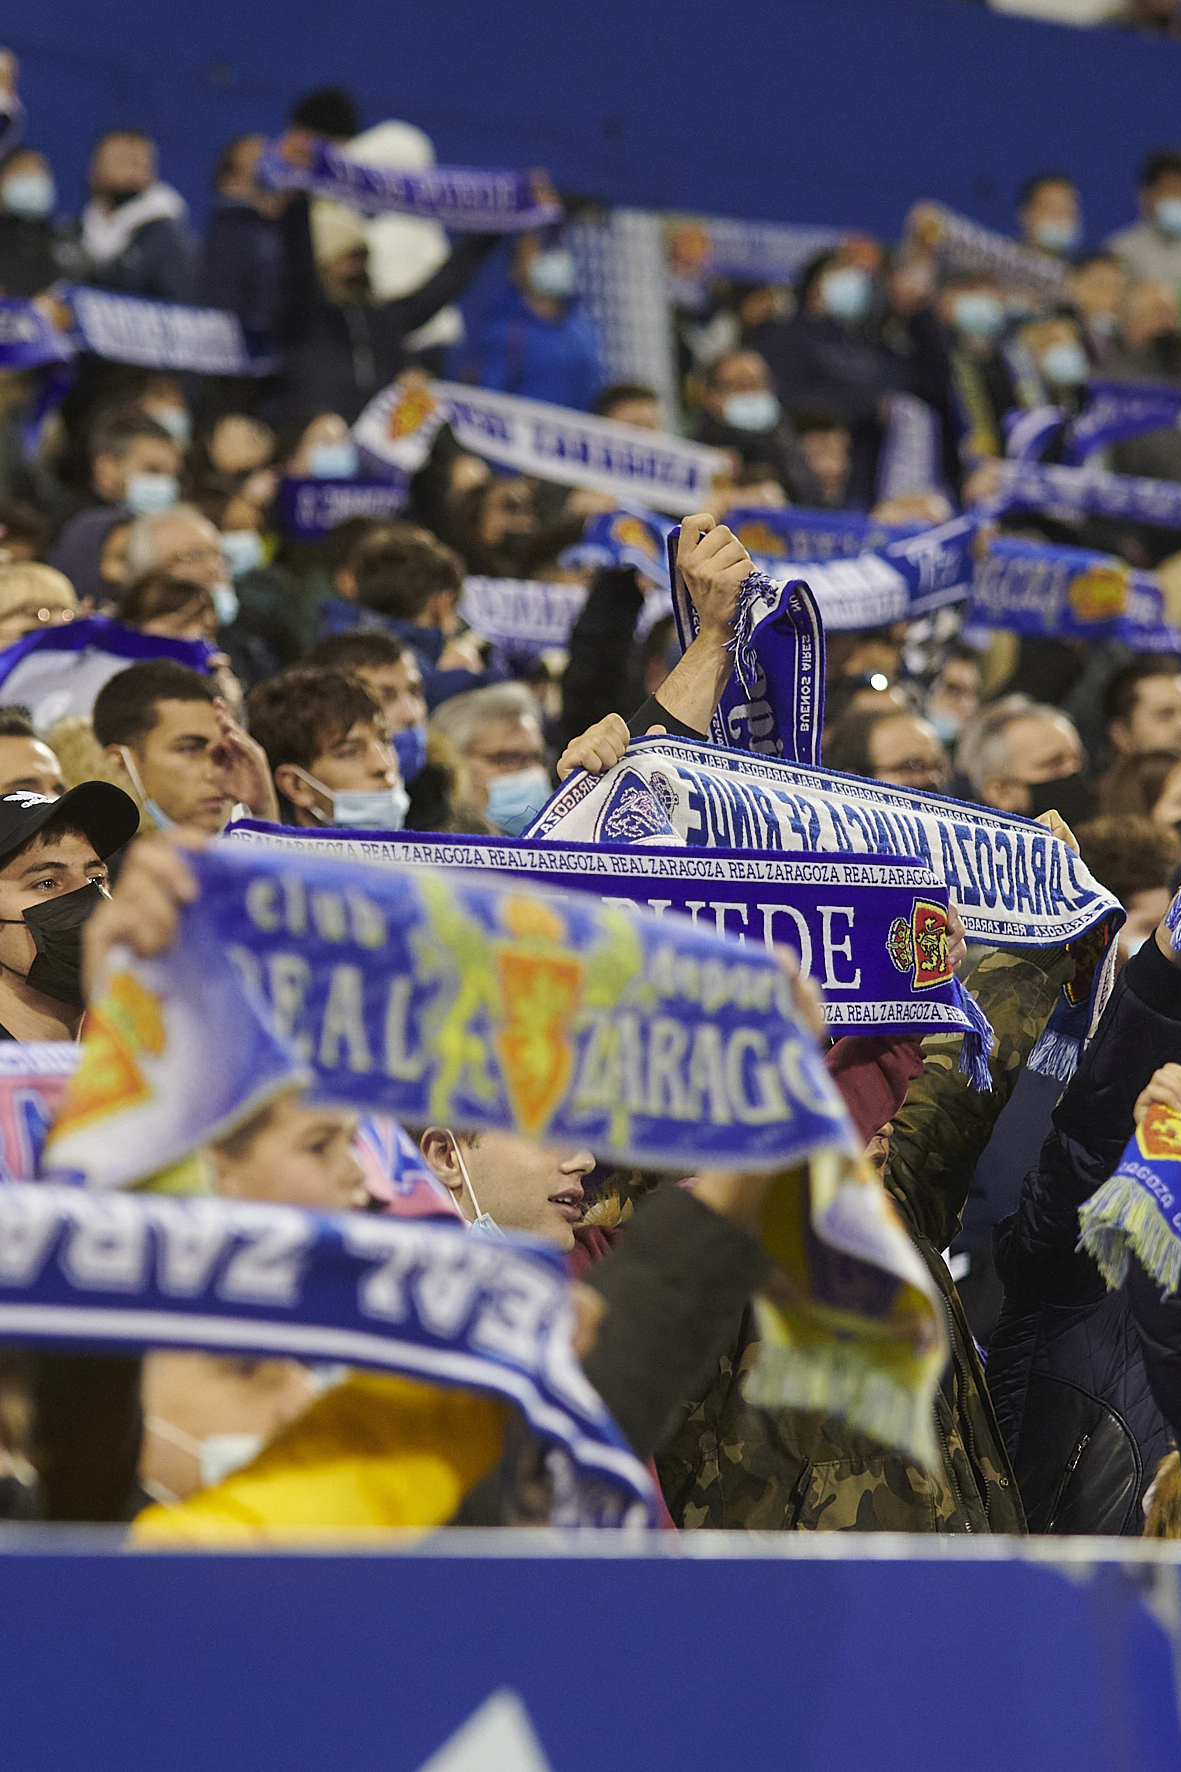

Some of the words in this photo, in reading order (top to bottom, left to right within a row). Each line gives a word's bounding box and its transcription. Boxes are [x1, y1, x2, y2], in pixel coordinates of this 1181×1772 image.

[360, 843, 402, 863] REAL
[402, 845, 485, 866] ZARAGOZA
[488, 849, 527, 868] REAL
[527, 852, 607, 872] ZARAGOZA
[612, 857, 649, 875] REAL
[648, 858, 726, 879] ZARAGOZA
[730, 861, 766, 879] REAL
[765, 862, 841, 883] ZARAGOZA
[844, 866, 880, 884] REAL
[847, 1004, 879, 1022] REAL
[880, 1003, 942, 1021] ZARAGOZA
[945, 1005, 967, 1023] RE
[573, 1009, 848, 1125] ZARAGO
[0, 1200, 304, 1309] ZARA
